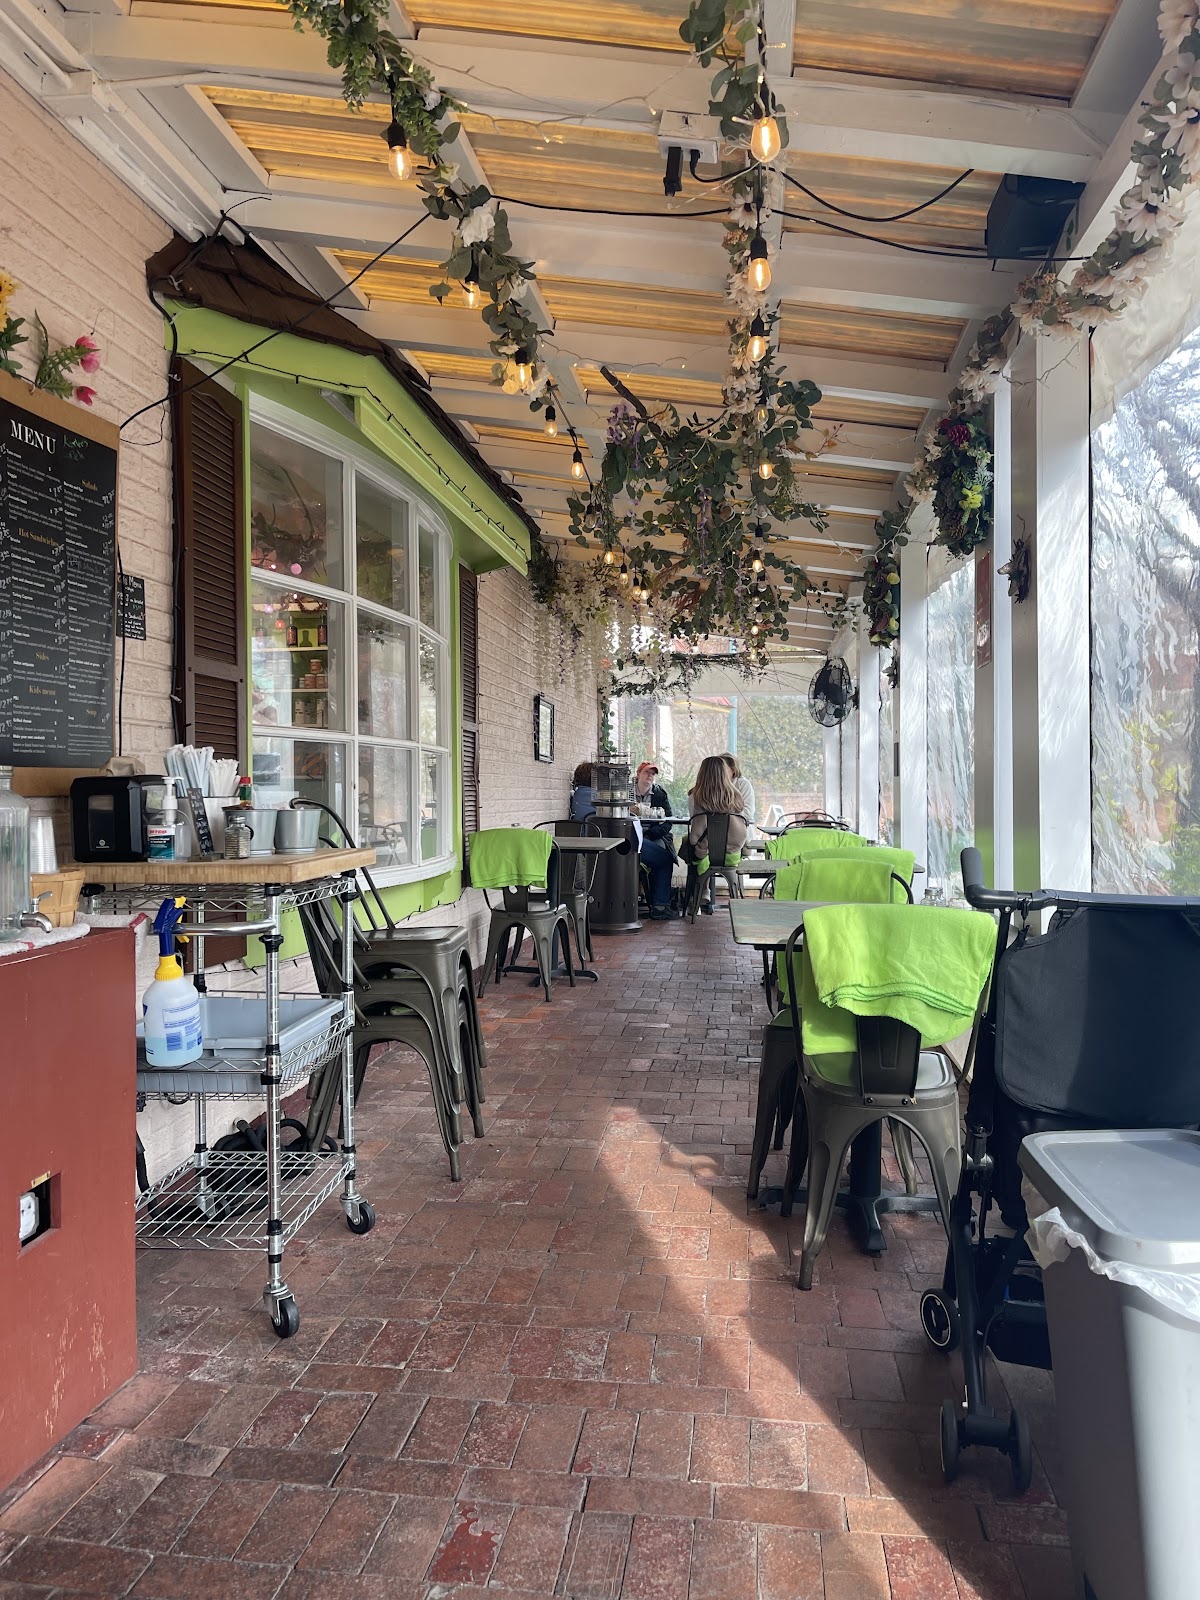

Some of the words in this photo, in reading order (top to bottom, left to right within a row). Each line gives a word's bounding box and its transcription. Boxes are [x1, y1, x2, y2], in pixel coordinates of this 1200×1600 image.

[10, 419, 56, 455] MENU
[19, 528, 29, 538] Hot
[30, 531, 60, 548] Sandwiches
[36, 652, 49, 661] Sides
[29, 685, 41, 695] Kids
